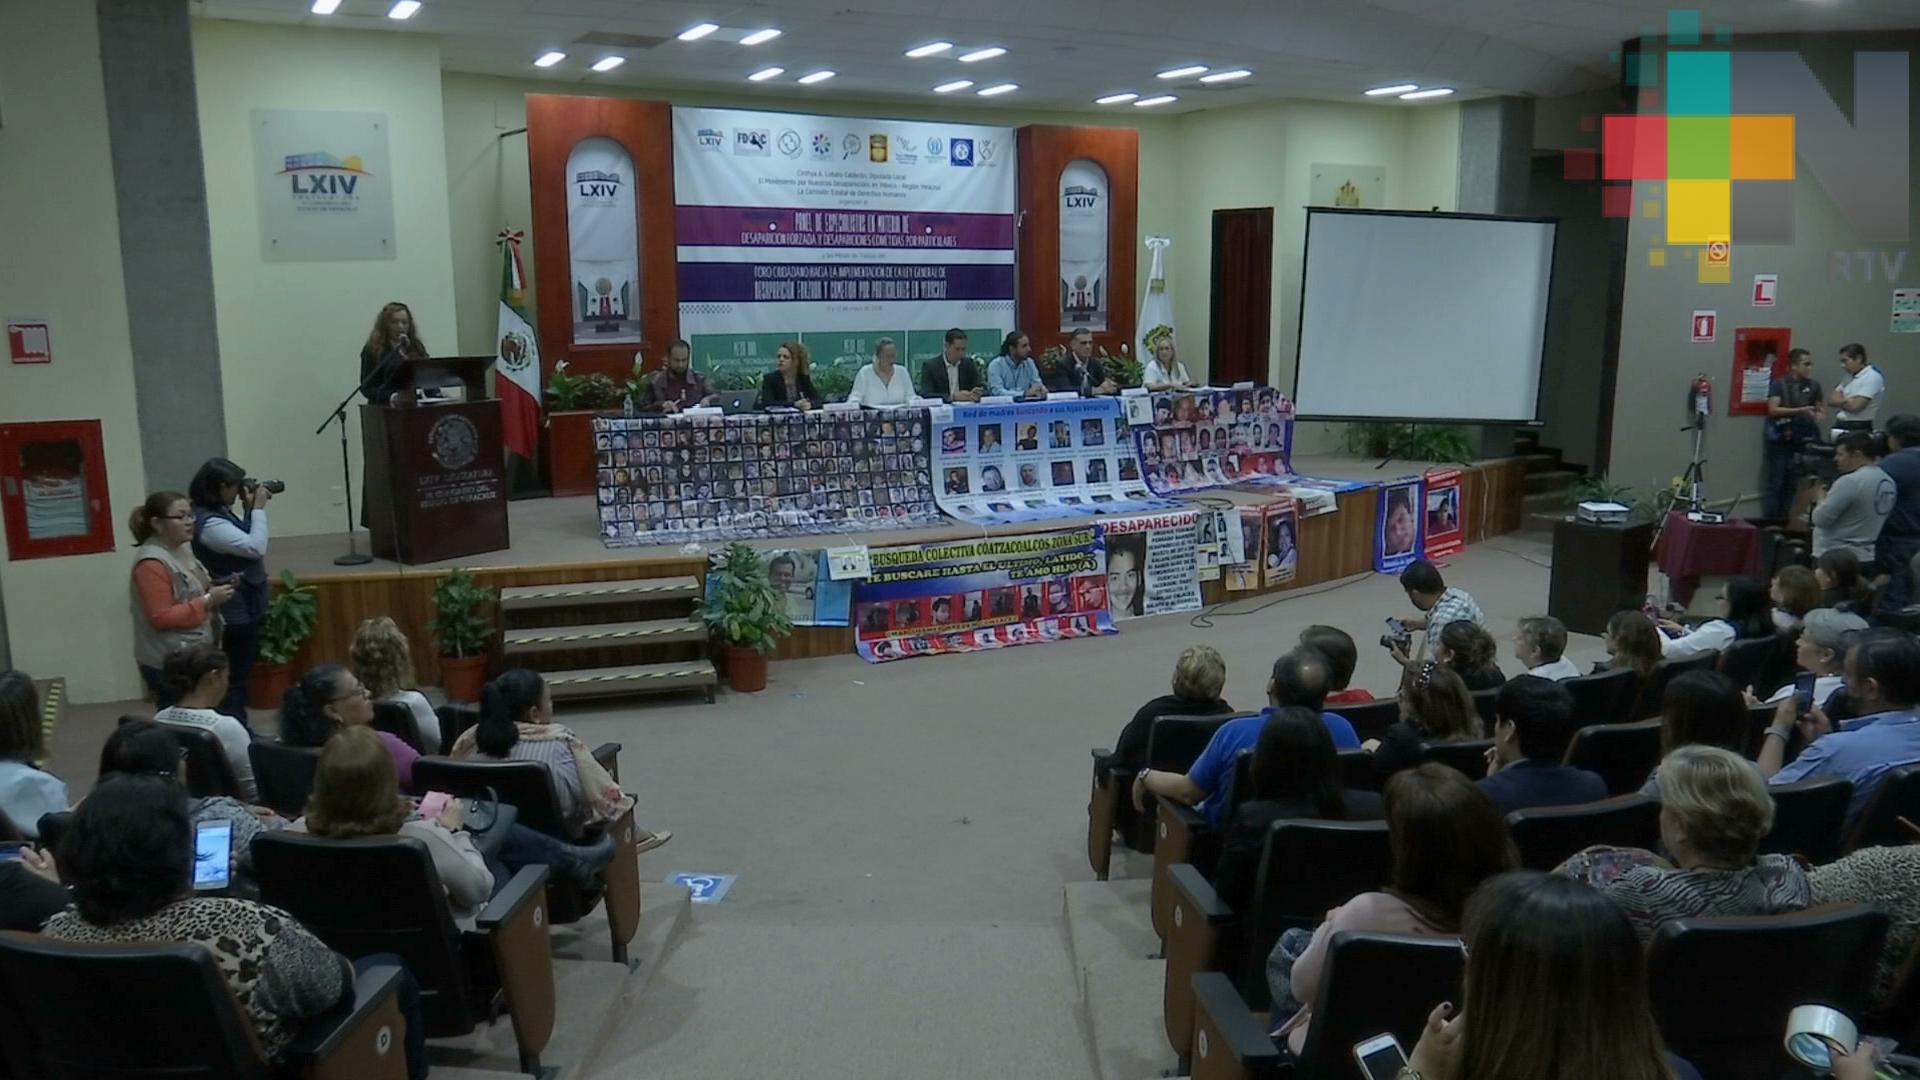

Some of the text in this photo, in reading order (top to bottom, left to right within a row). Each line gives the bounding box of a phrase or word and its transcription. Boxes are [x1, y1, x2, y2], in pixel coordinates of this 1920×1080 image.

[698, 136, 722, 146] LXIV
[292, 174, 357, 194] LXIV
[579, 184, 618, 197] LXIV
[1066, 197, 1096, 208] LXIV
[754, 264, 772, 279] FORO
[1102, 512, 1199, 533] DESAPARECIDO
[926, 544, 975, 562] COLECTIVA
[976, 538, 1051, 555] COATZACOALCOS
[882, 567, 941, 581] BUSCARE
[942, 562, 980, 576] HASTA
[982, 561, 997, 570] EL
[1010, 570, 1025, 579] TE
[1026, 566, 1051, 577] AMO
